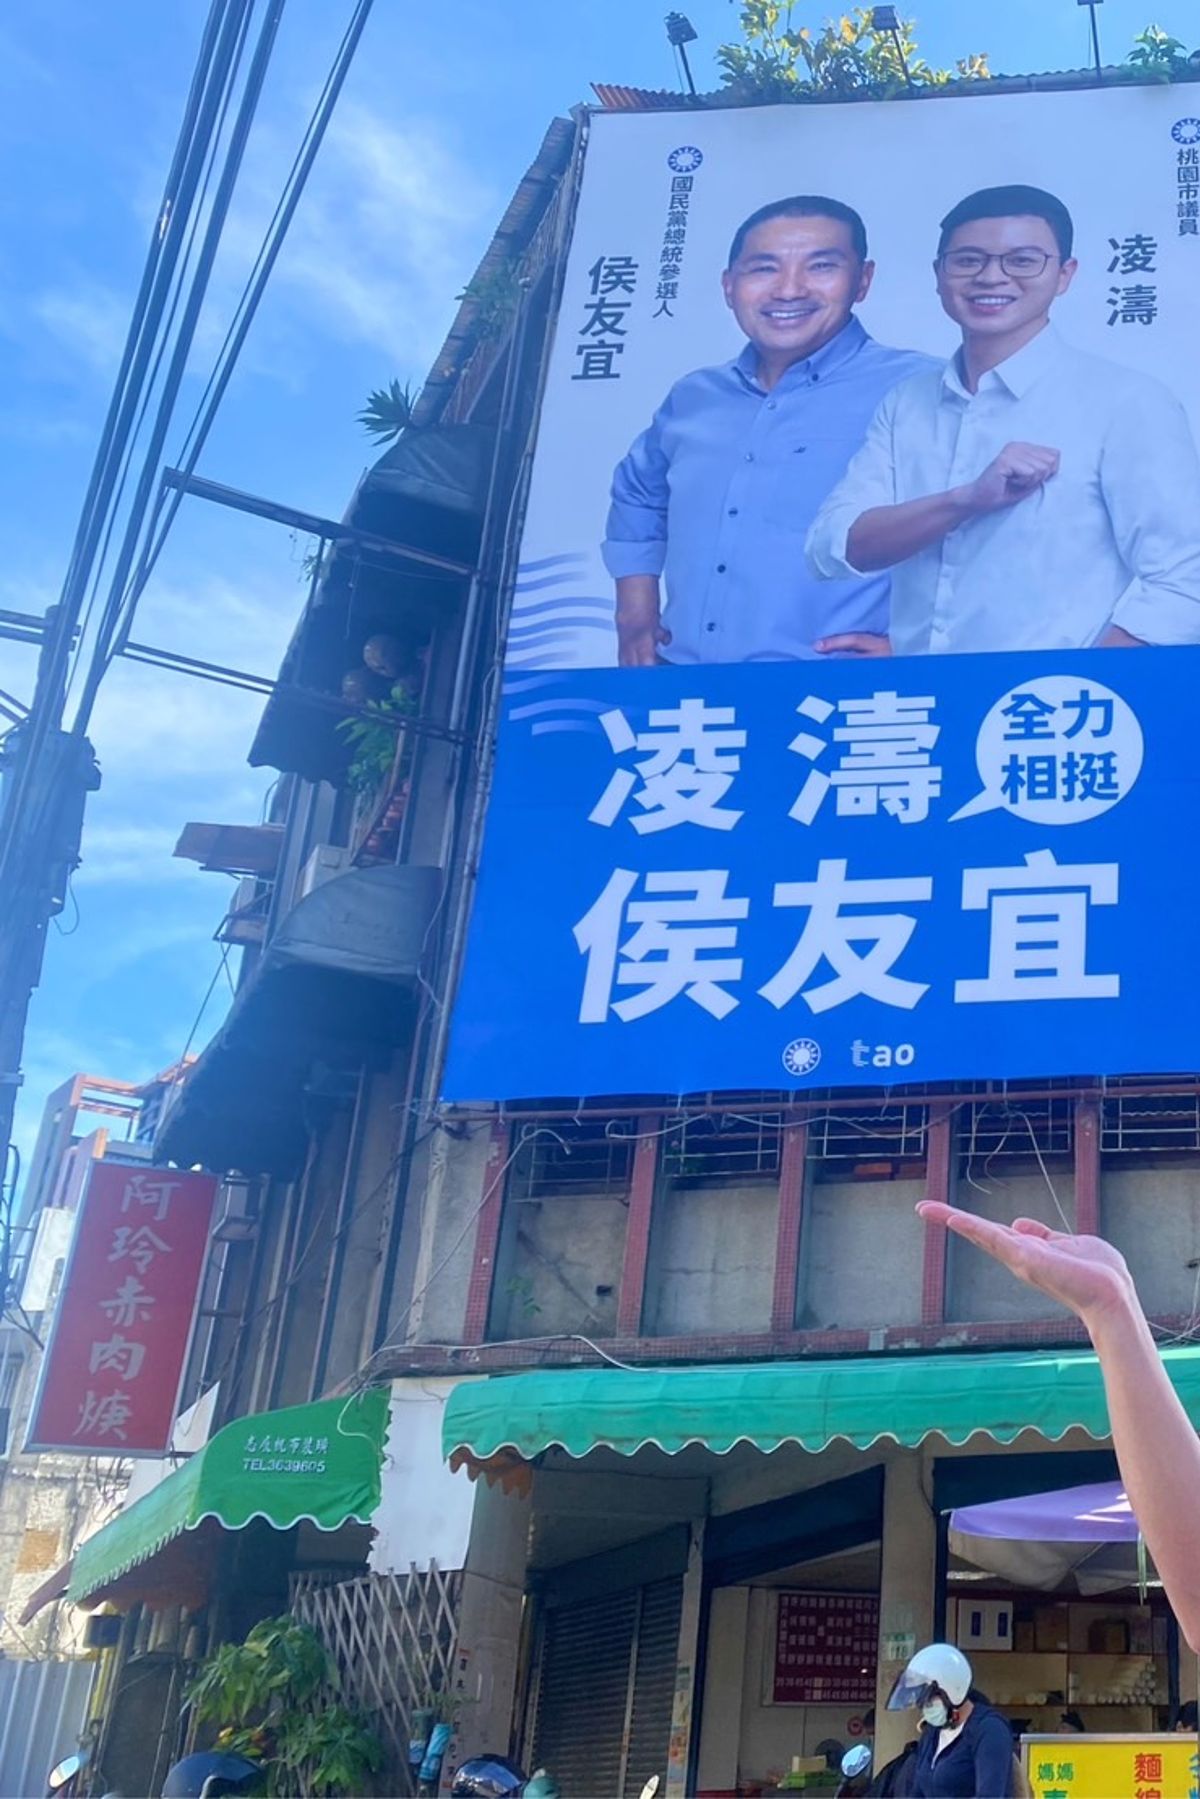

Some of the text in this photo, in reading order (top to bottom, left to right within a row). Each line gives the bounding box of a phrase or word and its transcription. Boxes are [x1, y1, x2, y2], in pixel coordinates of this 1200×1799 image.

[1177, 148, 1200, 237] 桃園市議員
[652, 175, 694, 319] 國民黨總統參選人
[1106, 234, 1158, 327] 凌濤
[571, 255, 639, 382] 侯友宜
[1000, 690, 1115, 743] 全力
[586, 690, 943, 837] 凌濤
[1000, 751, 1121, 806] 相挺
[571, 848, 1121, 1025] 侯友宜
[851, 1039, 915, 1068] tao
